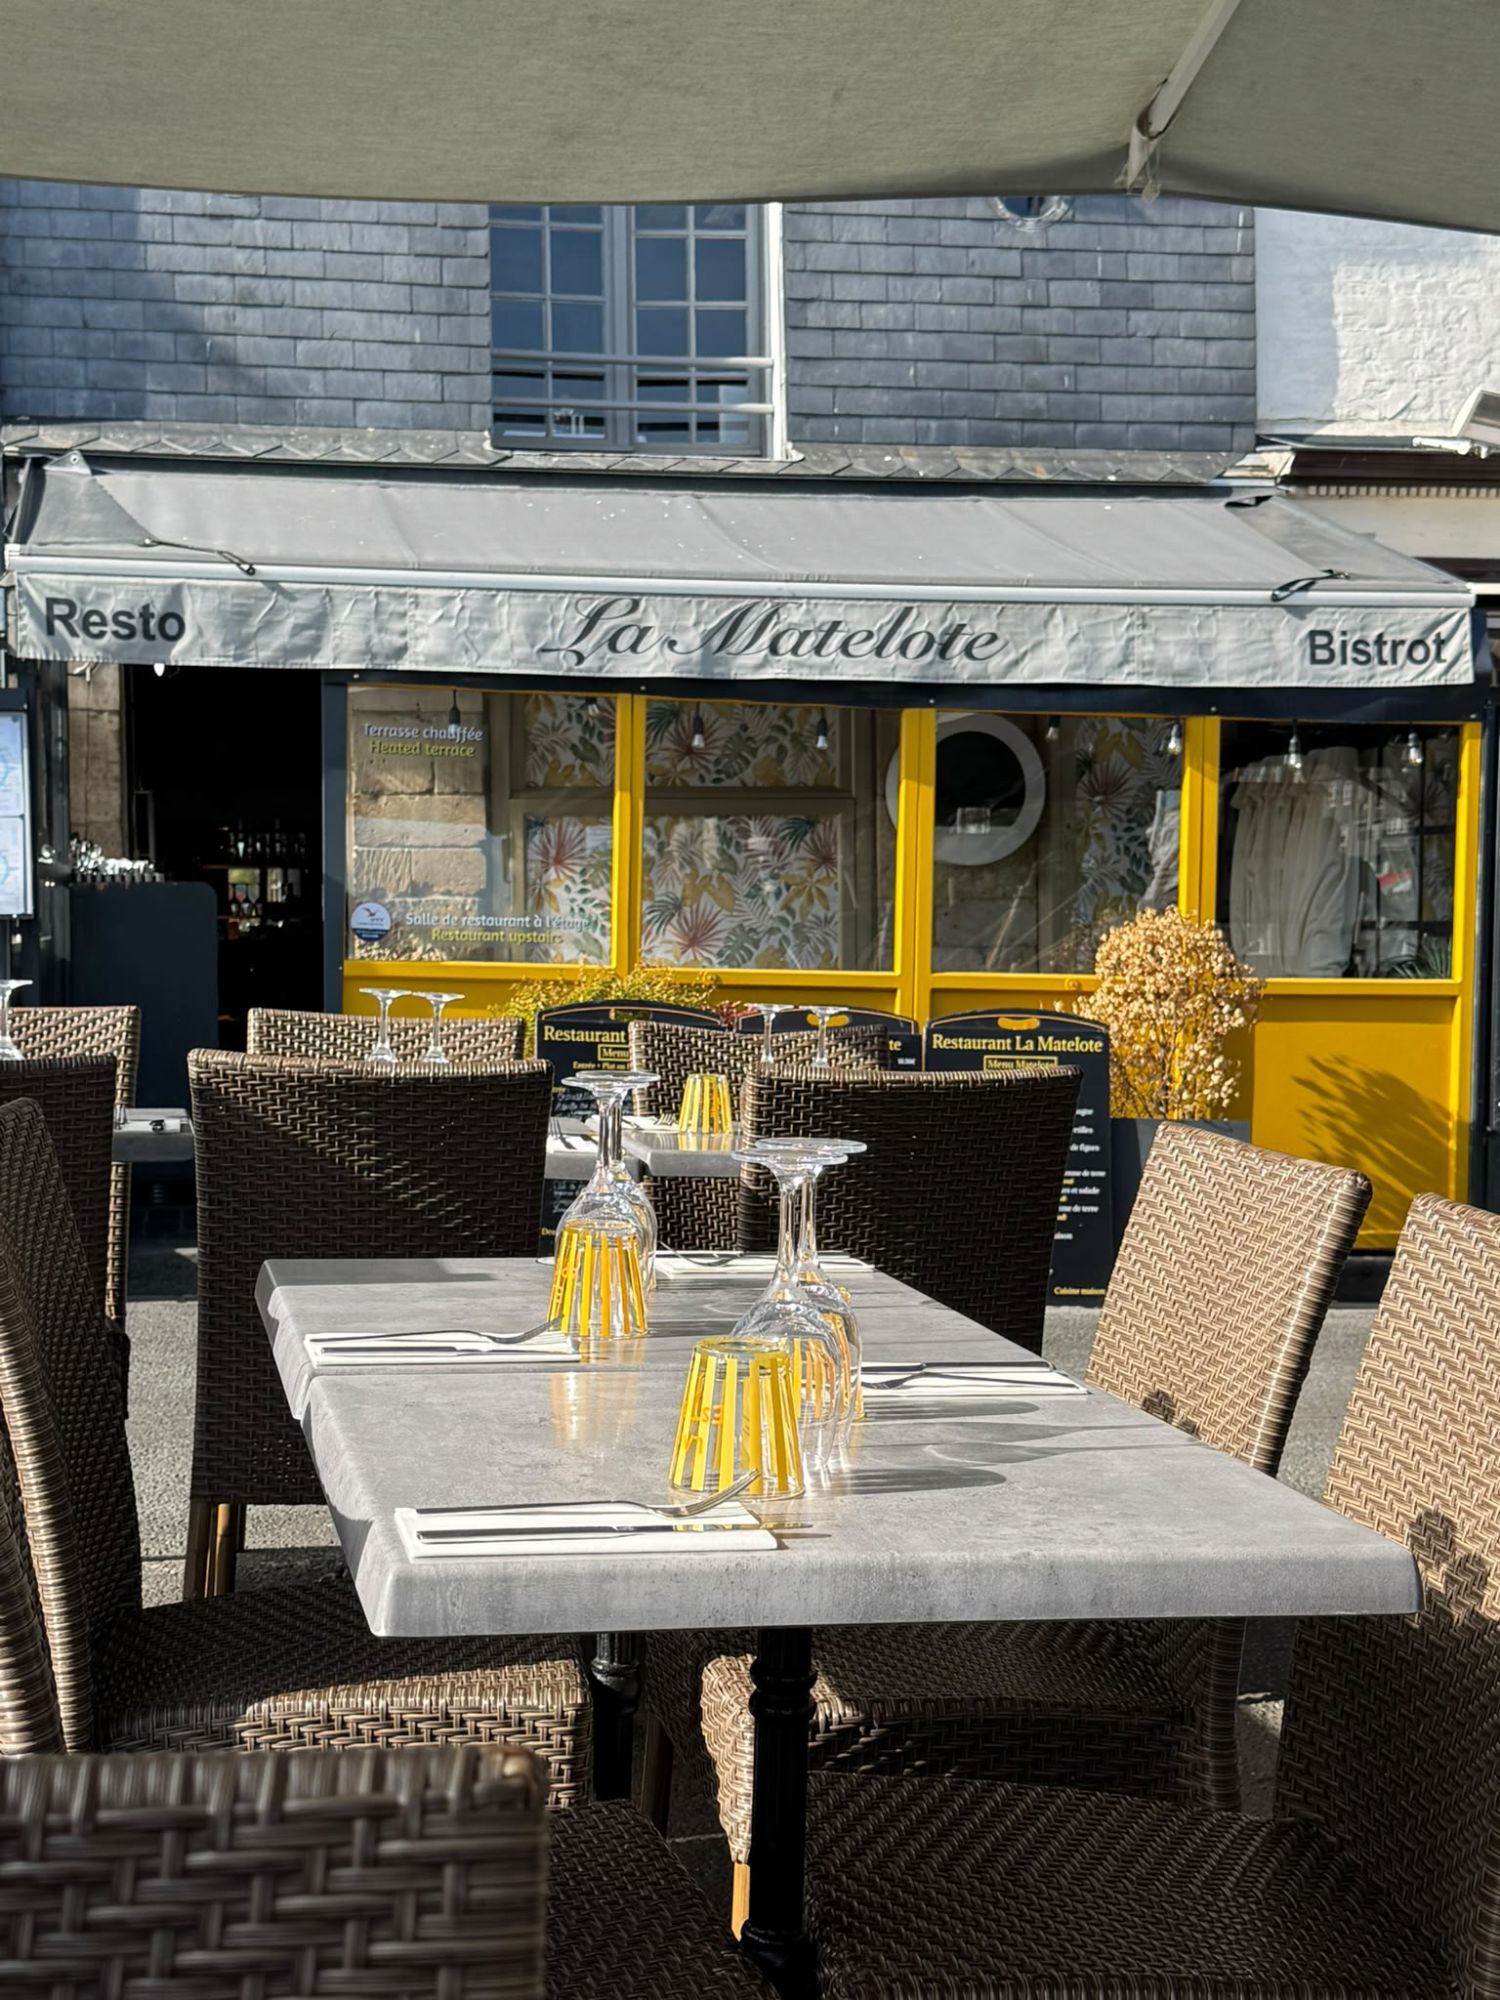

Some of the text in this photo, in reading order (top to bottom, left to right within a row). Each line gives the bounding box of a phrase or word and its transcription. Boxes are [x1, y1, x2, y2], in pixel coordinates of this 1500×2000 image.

[45, 596, 187, 643] Resto
[540, 597, 1009, 667] La Matelote
[1309, 628, 1448, 667] Bistrot
[363, 723, 483, 743] Terrasse chauffée
[368, 740, 476, 758] Heated terrace
[405, 912, 437, 926] Salle
[442, 913, 458, 927] de
[462, 914, 531, 929] restaurant
[533, 914, 543, 928] à
[431, 927, 564, 945] Restaurant upstairs
[543, 1025, 627, 1043] Restaurant
[932, 1033, 1104, 1053] Restaurant La Matelote
